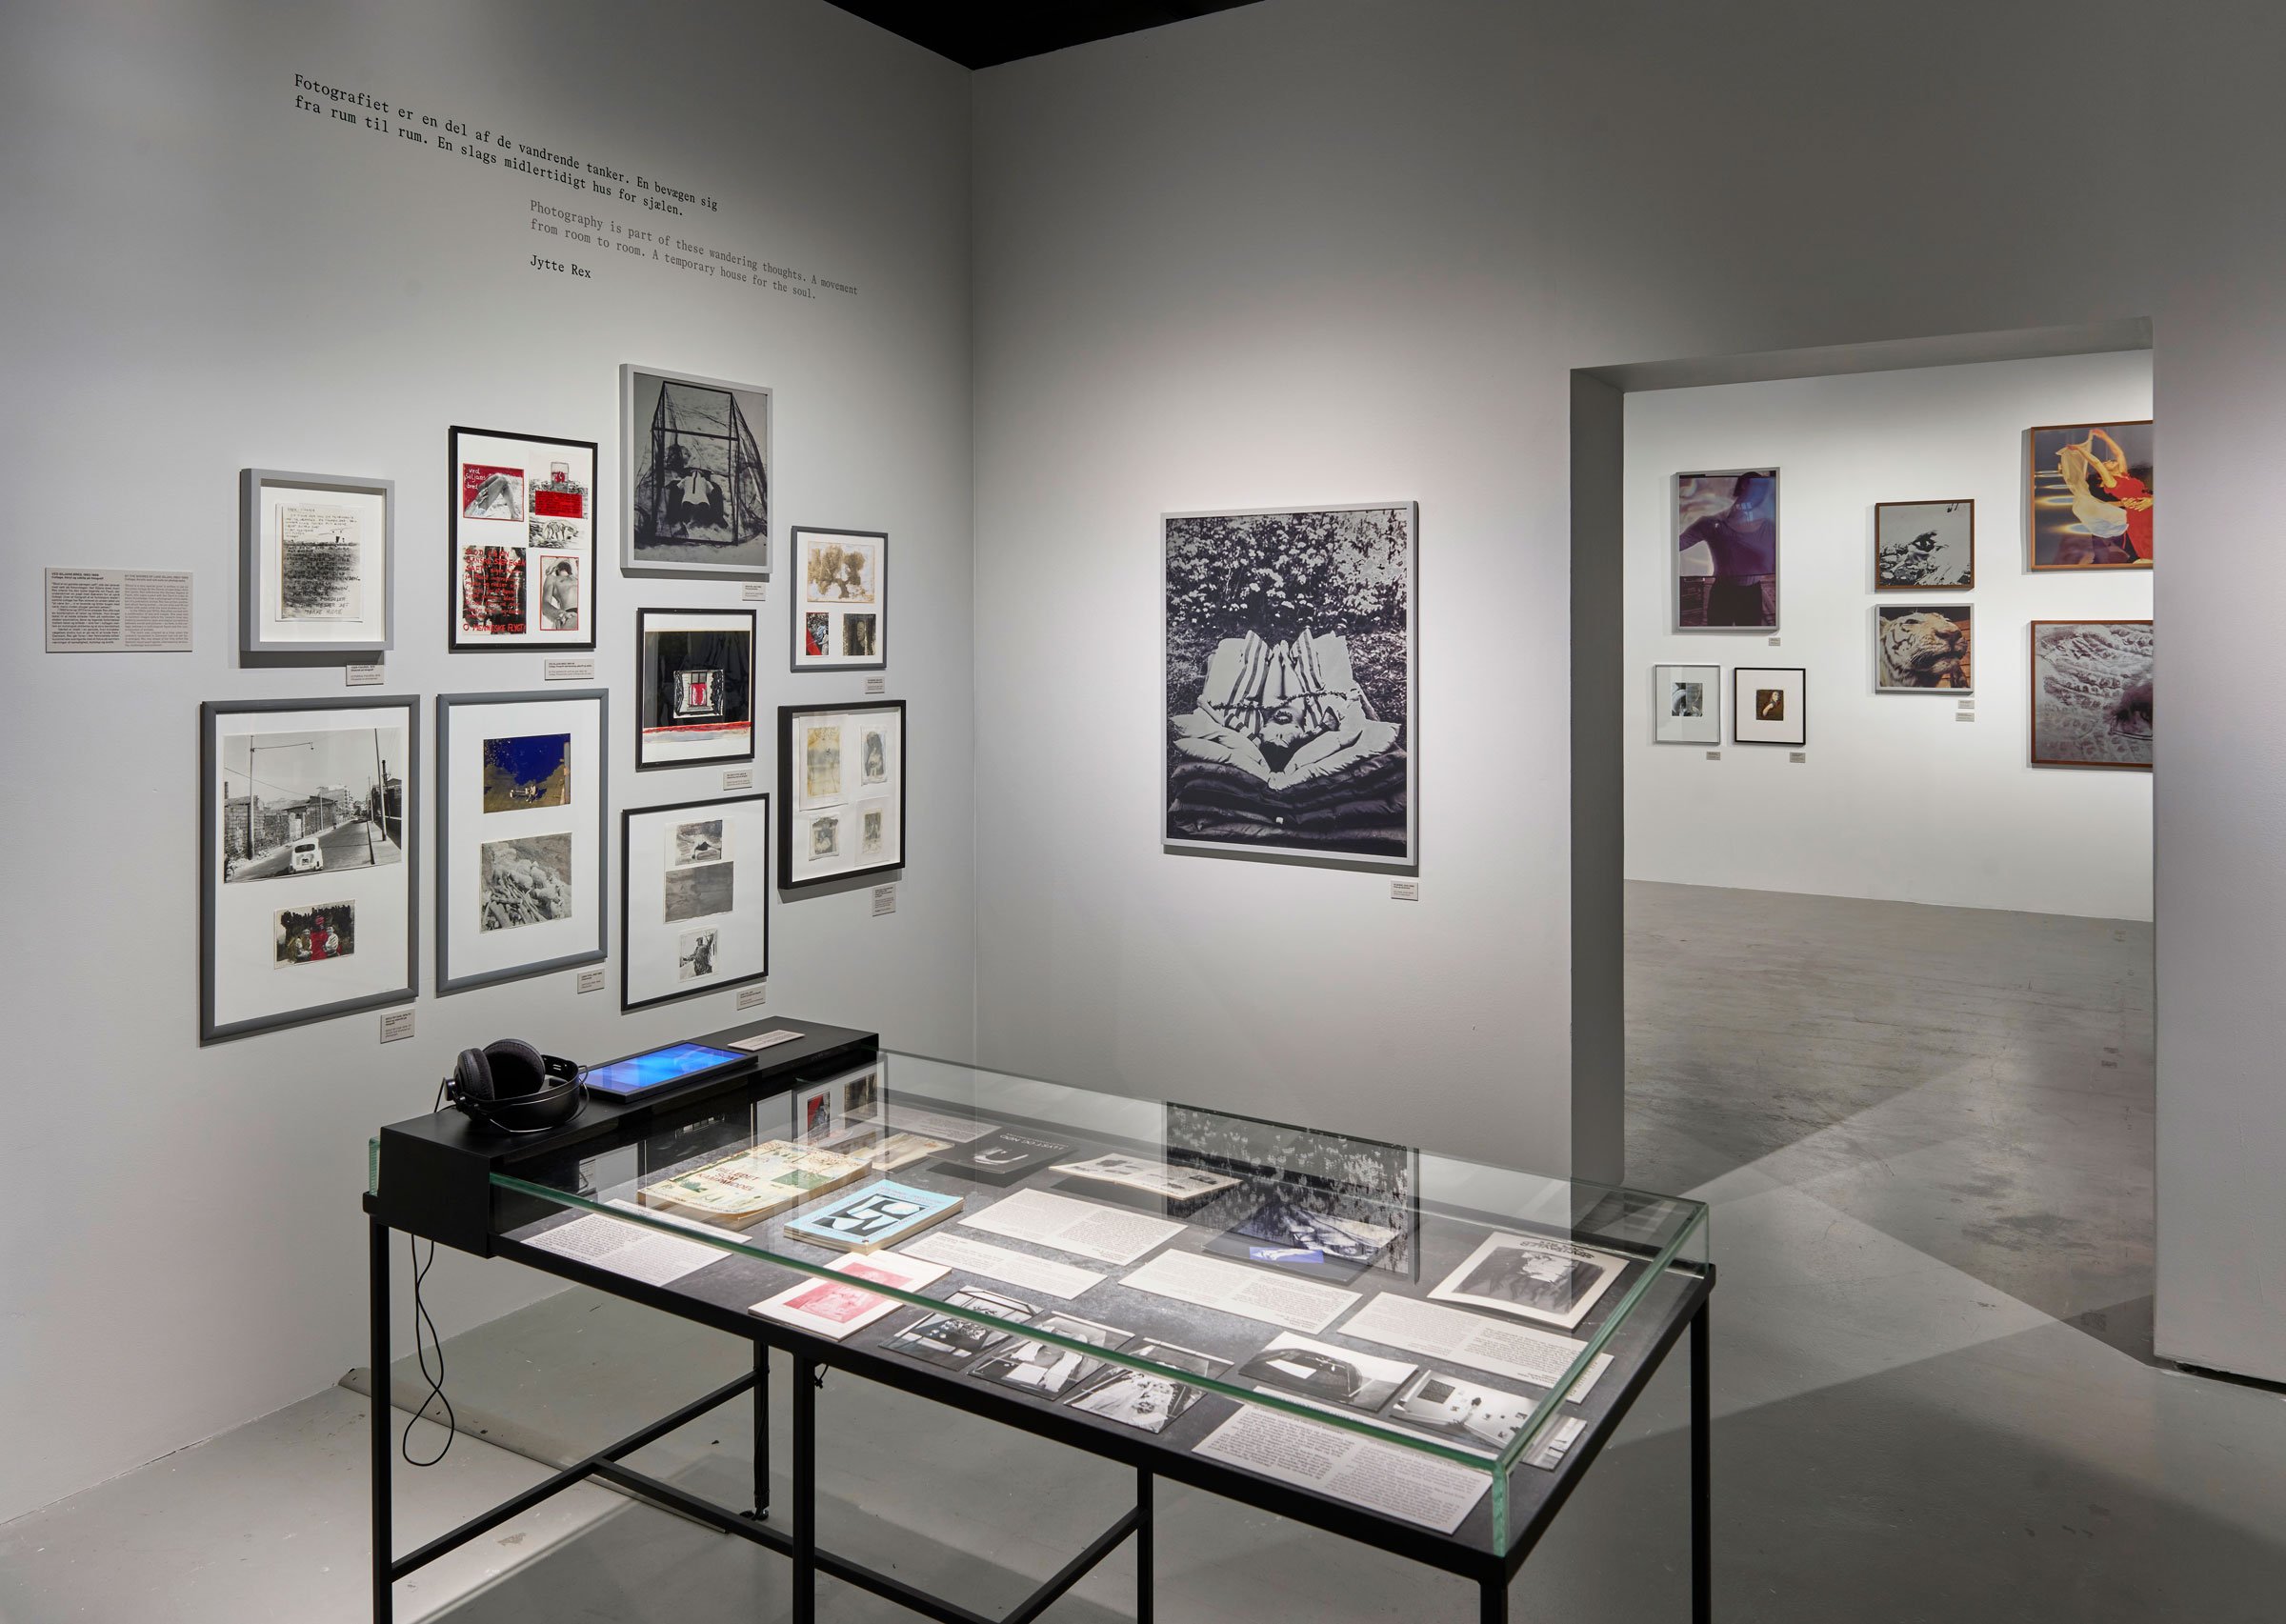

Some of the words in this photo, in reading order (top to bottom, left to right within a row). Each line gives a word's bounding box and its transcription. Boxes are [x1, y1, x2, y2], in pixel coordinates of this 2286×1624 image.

[294, 73, 389, 113] Fotografiet
[398, 109, 413, 120] er
[422, 115, 438, 128] en
[445, 119, 468, 136] del
[475, 130, 491, 143] af
[497, 135, 511, 150] de
[518, 144, 580, 170] vandrende
[587, 163, 629, 184] tanker.
[636, 176, 649, 190] En
[654, 181, 695, 203] bevægen
[701, 196, 717, 212] sig
[294, 94, 321, 114] fra
[331, 109, 356, 124] rum
[365, 116, 389, 133] til
[398, 128, 428, 144] rum.
[437, 135, 453, 151] En
[461, 145, 496, 165] slags
[504, 157, 586, 190] midlertidigt
[592, 180, 612, 196] hus
[618, 188, 637, 203] for
[643, 196, 683, 216] sjælen.
[530, 254, 565, 272] Jytte
[572, 264, 592, 279] Rex
[531, 199, 603, 231] Photography
[611, 221, 621, 233] is
[628, 229, 652, 242] part
[658, 235, 671, 246] of
[676, 239, 704, 255] these
[710, 250, 757, 271] wandering
[763, 262, 806, 282] thoughts.
[812, 274, 817, 285] A
[821, 279, 857, 295] movement
[531, 218, 558, 235] from
[565, 230, 591, 244] room
[597, 236, 610, 248] to
[616, 243, 645, 256] room.
[652, 250, 659, 260] A
[665, 253, 715, 276] temporary
[720, 266, 747, 282] house
[752, 274, 768, 287] for
[772, 280, 788, 292] the
[792, 288, 815, 299] soul.
